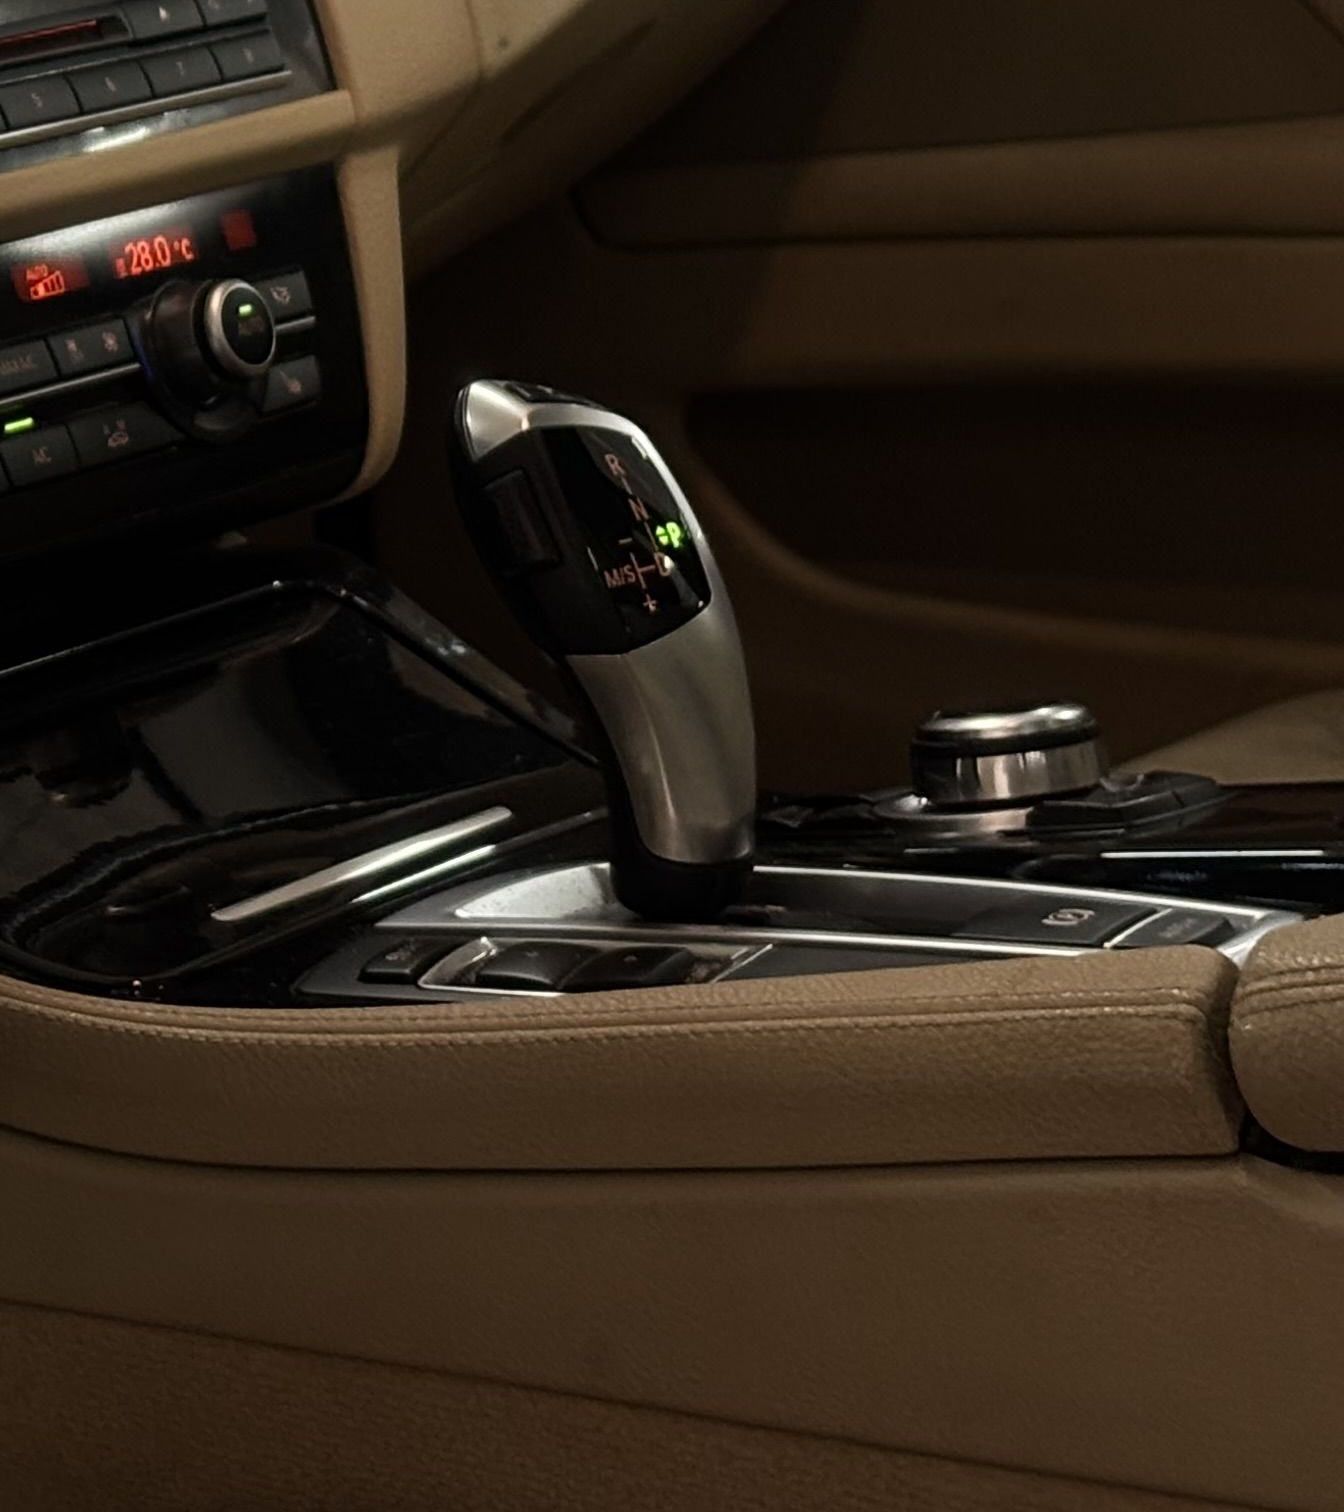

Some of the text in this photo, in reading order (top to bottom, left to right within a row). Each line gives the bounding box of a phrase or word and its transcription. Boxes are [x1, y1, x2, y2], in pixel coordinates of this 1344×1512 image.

[124, 235, 194, 276] 28.0 °C
[604, 453, 626, 476] R
[628, 497, 650, 521] N
[665, 521, 682, 548] P
[603, 564, 636, 588] M/S
